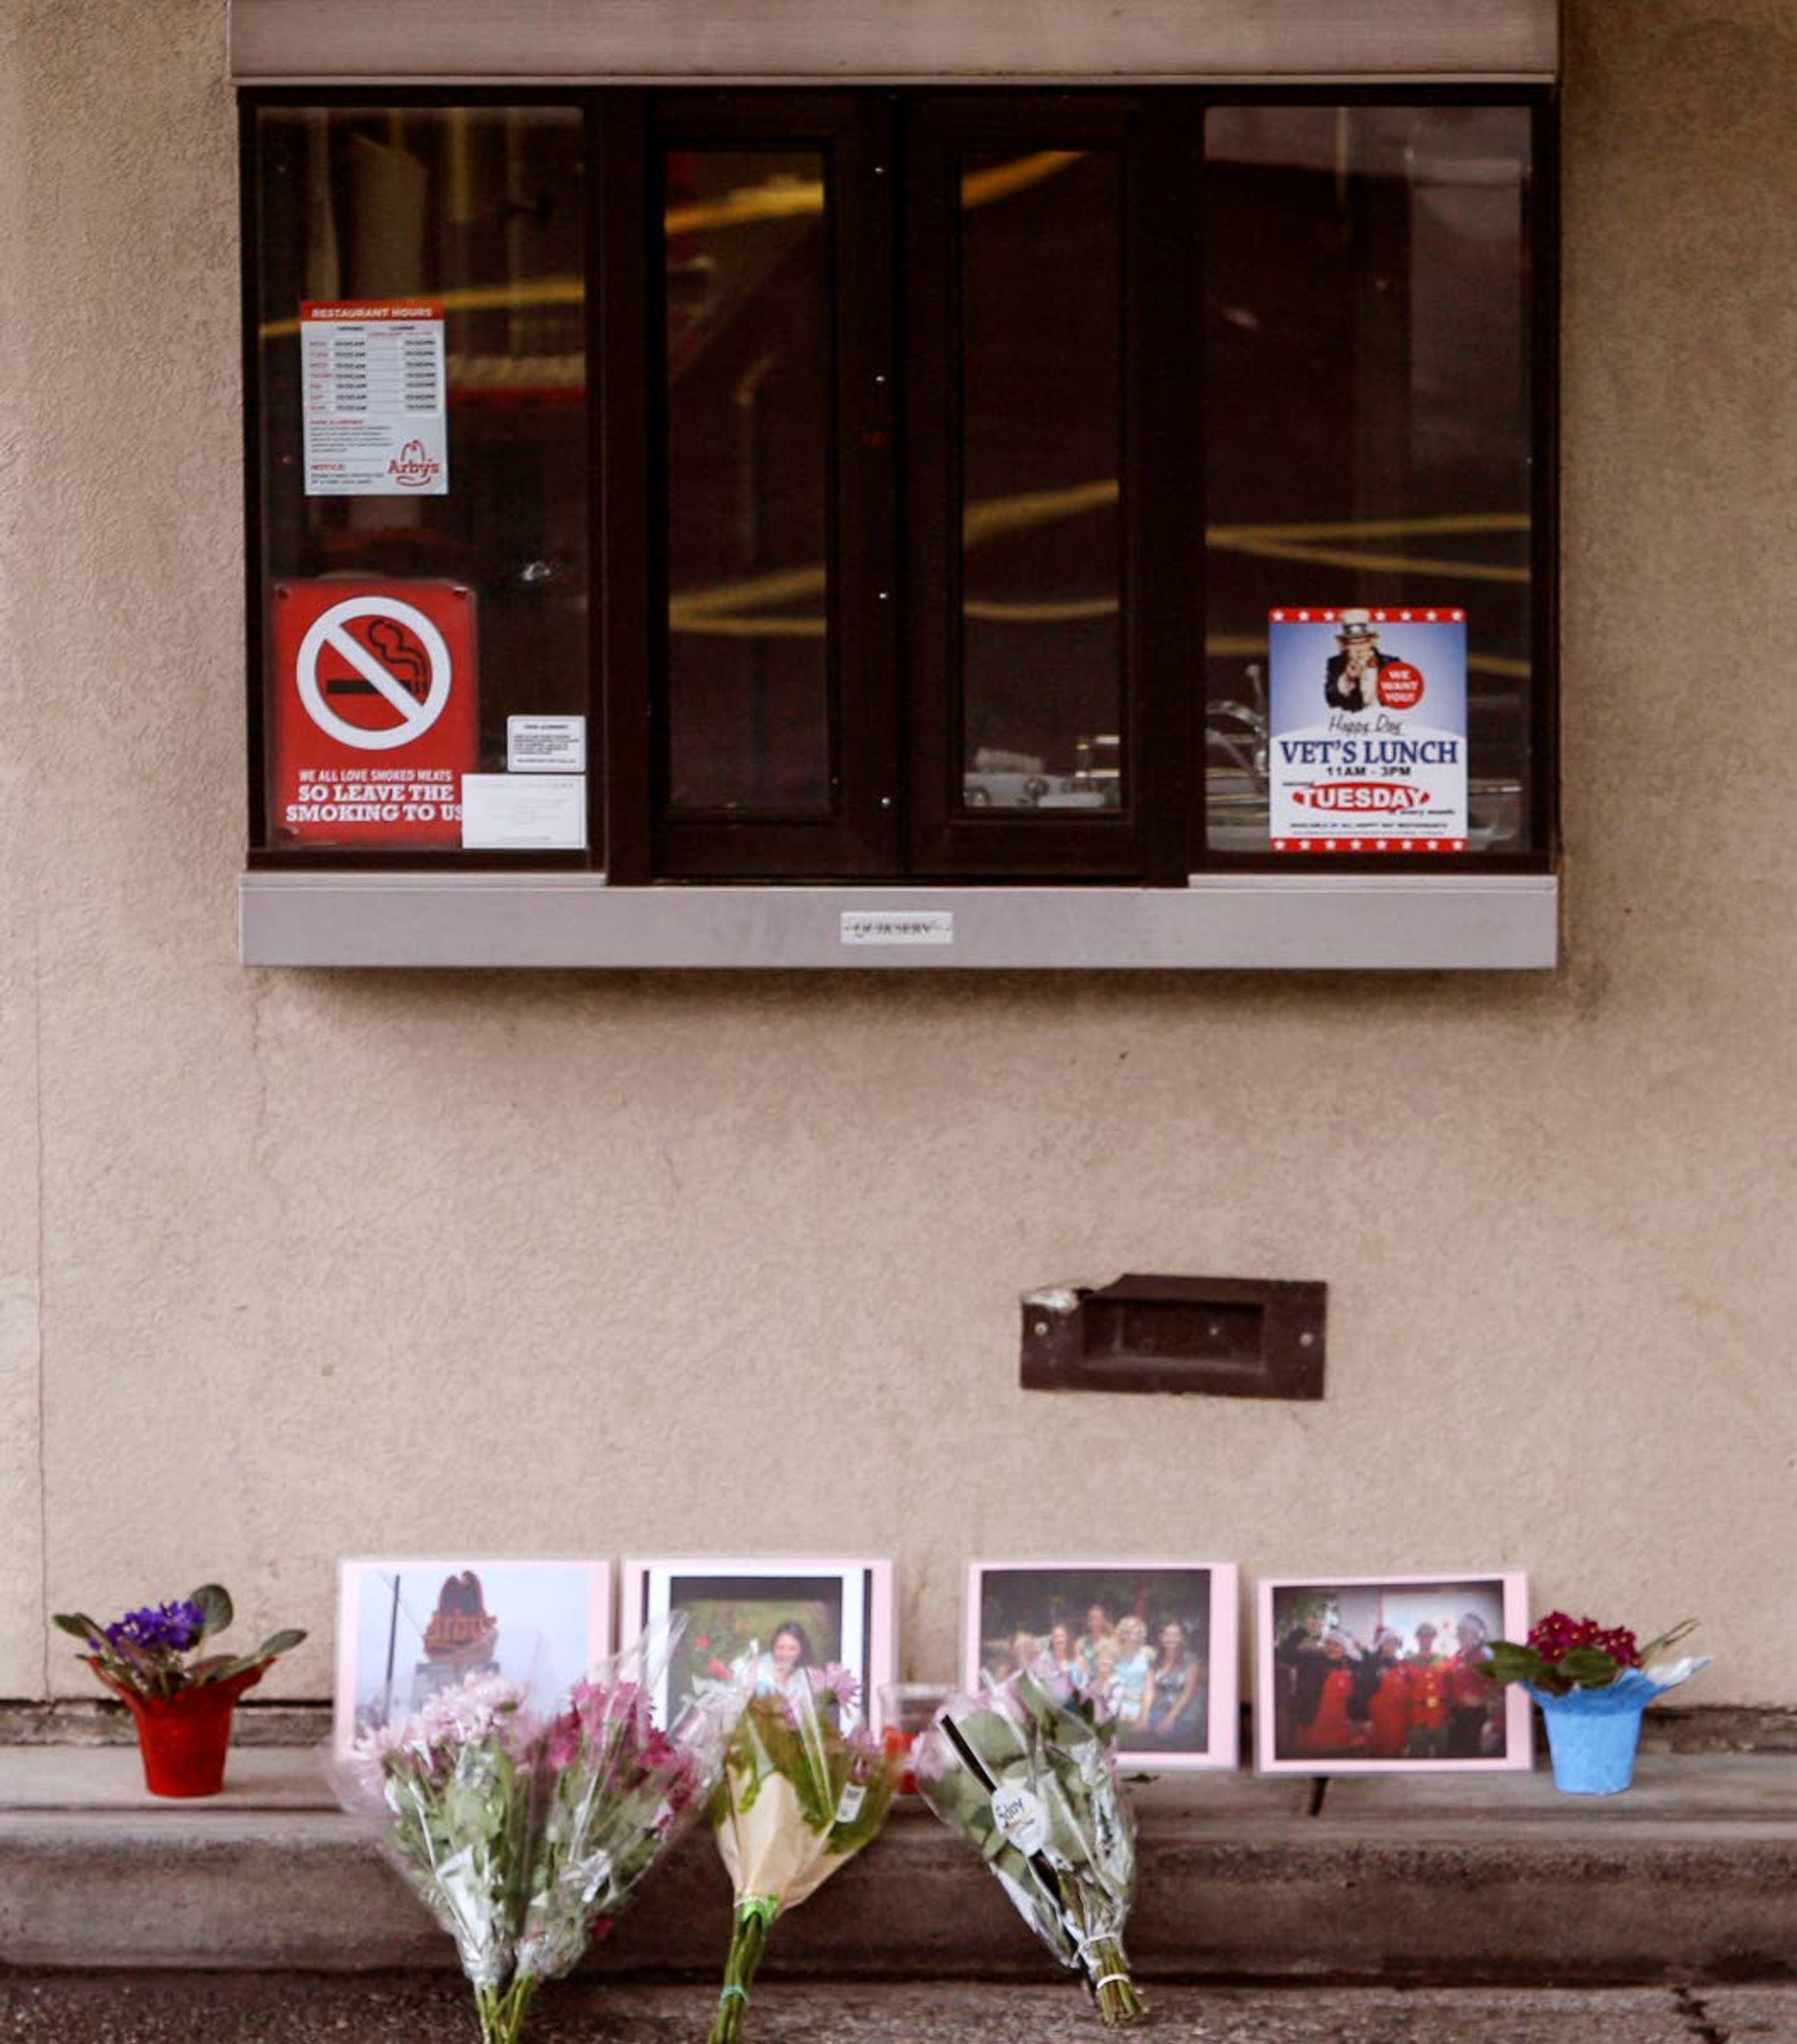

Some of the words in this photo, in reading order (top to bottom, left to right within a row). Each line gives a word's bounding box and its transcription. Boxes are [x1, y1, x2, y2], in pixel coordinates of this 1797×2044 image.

[312, 308, 389, 318] RESTAURANT
[391, 307, 433, 317] HOURS
[387, 458, 441, 478] Arby's
[1388, 670, 1410, 679] WE
[1380, 681, 1419, 690] WANT
[1328, 714, 1369, 736] Happy
[1375, 713, 1404, 736] Day
[1280, 740, 1357, 764] VET'S
[1364, 740, 1458, 764] LUNCH
[299, 770, 316, 782] WE
[318, 770, 338, 782] ALL
[341, 770, 368, 782] LOVE
[372, 770, 415, 781] SMOKED
[417, 770, 452, 781] MEATS
[1327, 767, 1366, 776] 11AM
[1381, 767, 1411, 776] 3PM
[298, 784, 329, 802] SO
[333, 784, 405, 801] LEAVE
[408, 784, 453, 801] THE
[1301, 788, 1424, 808] TUESDAY
[286, 803, 399, 822] SMOKING
[403, 803, 436, 821] TO
